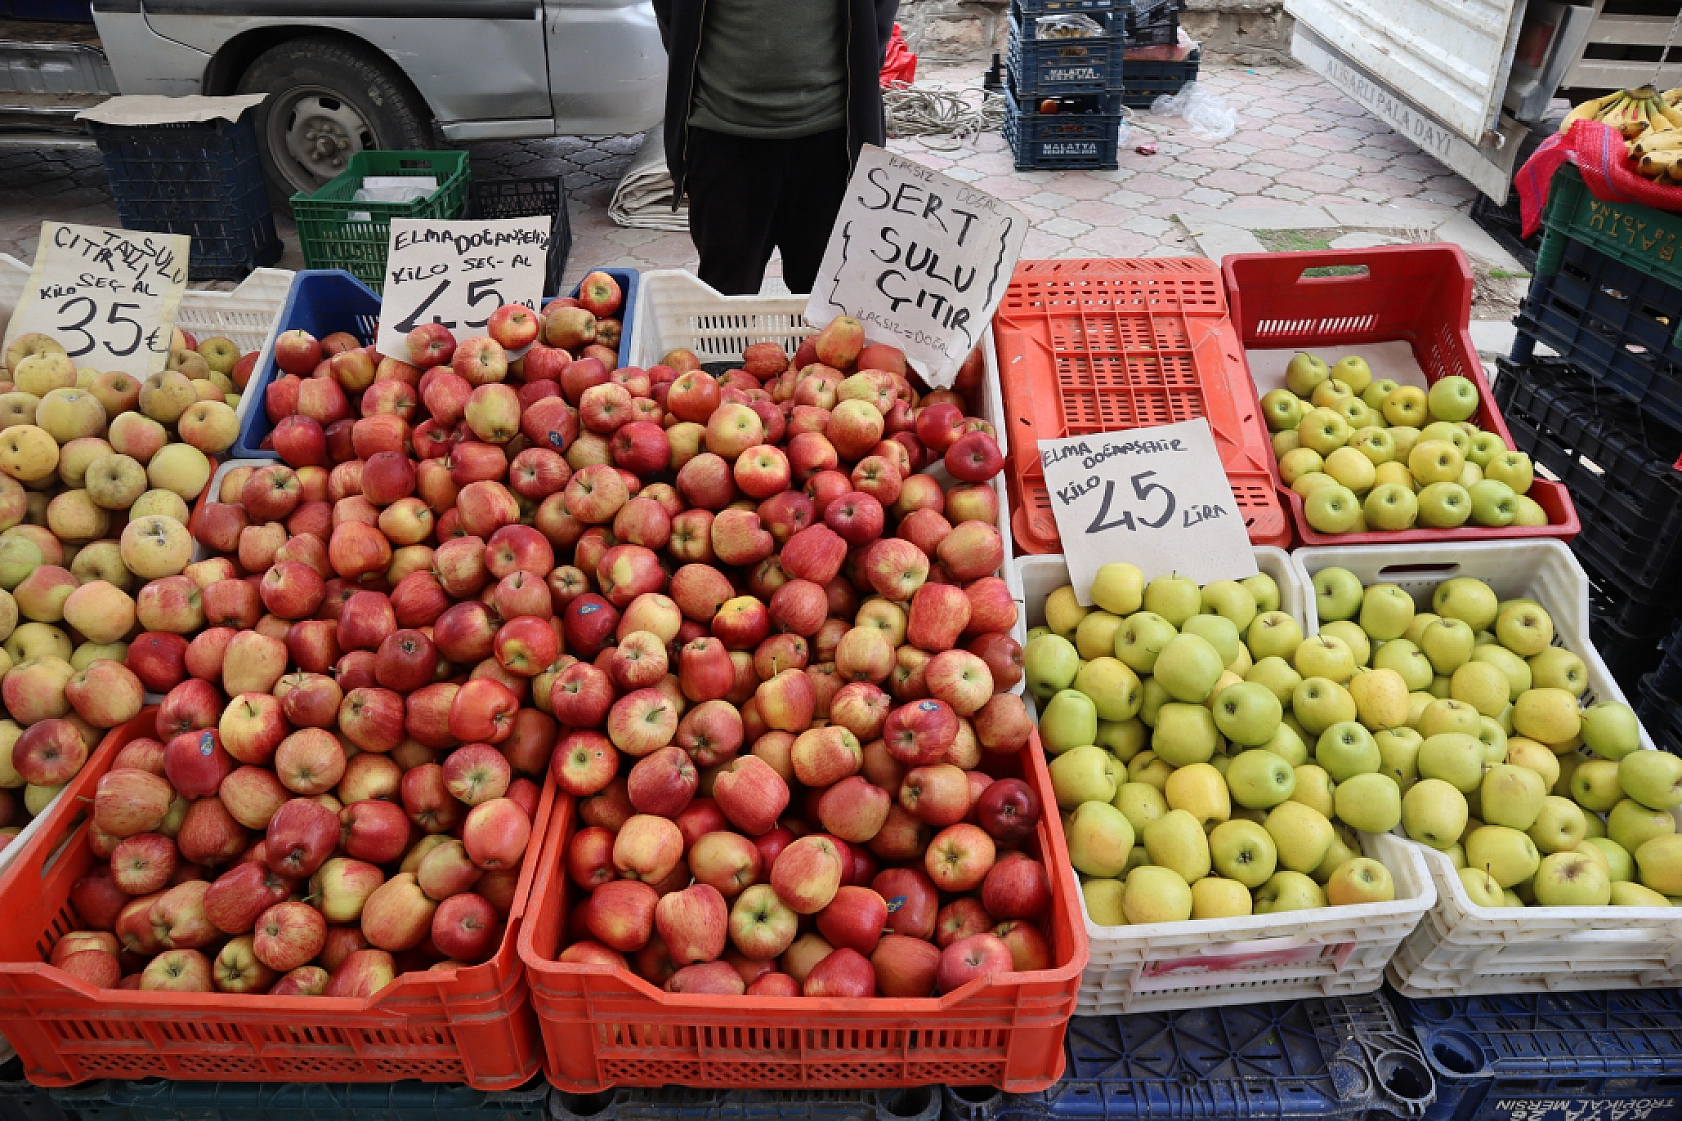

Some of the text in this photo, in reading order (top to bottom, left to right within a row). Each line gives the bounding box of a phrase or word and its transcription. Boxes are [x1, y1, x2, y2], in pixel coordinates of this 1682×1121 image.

[858, 167, 978, 247] SERT
[144, 237, 186, 285] SULU
[394, 228, 453, 251] ELMA
[511, 254, 532, 268] AL
[870, 227, 976, 293] SULU
[132, 281, 159, 297] AL
[393, 278, 505, 333] 45
[57, 296, 143, 357] 35
[1043, 441, 1092, 468] ELMA
[1085, 470, 1176, 534] 45
